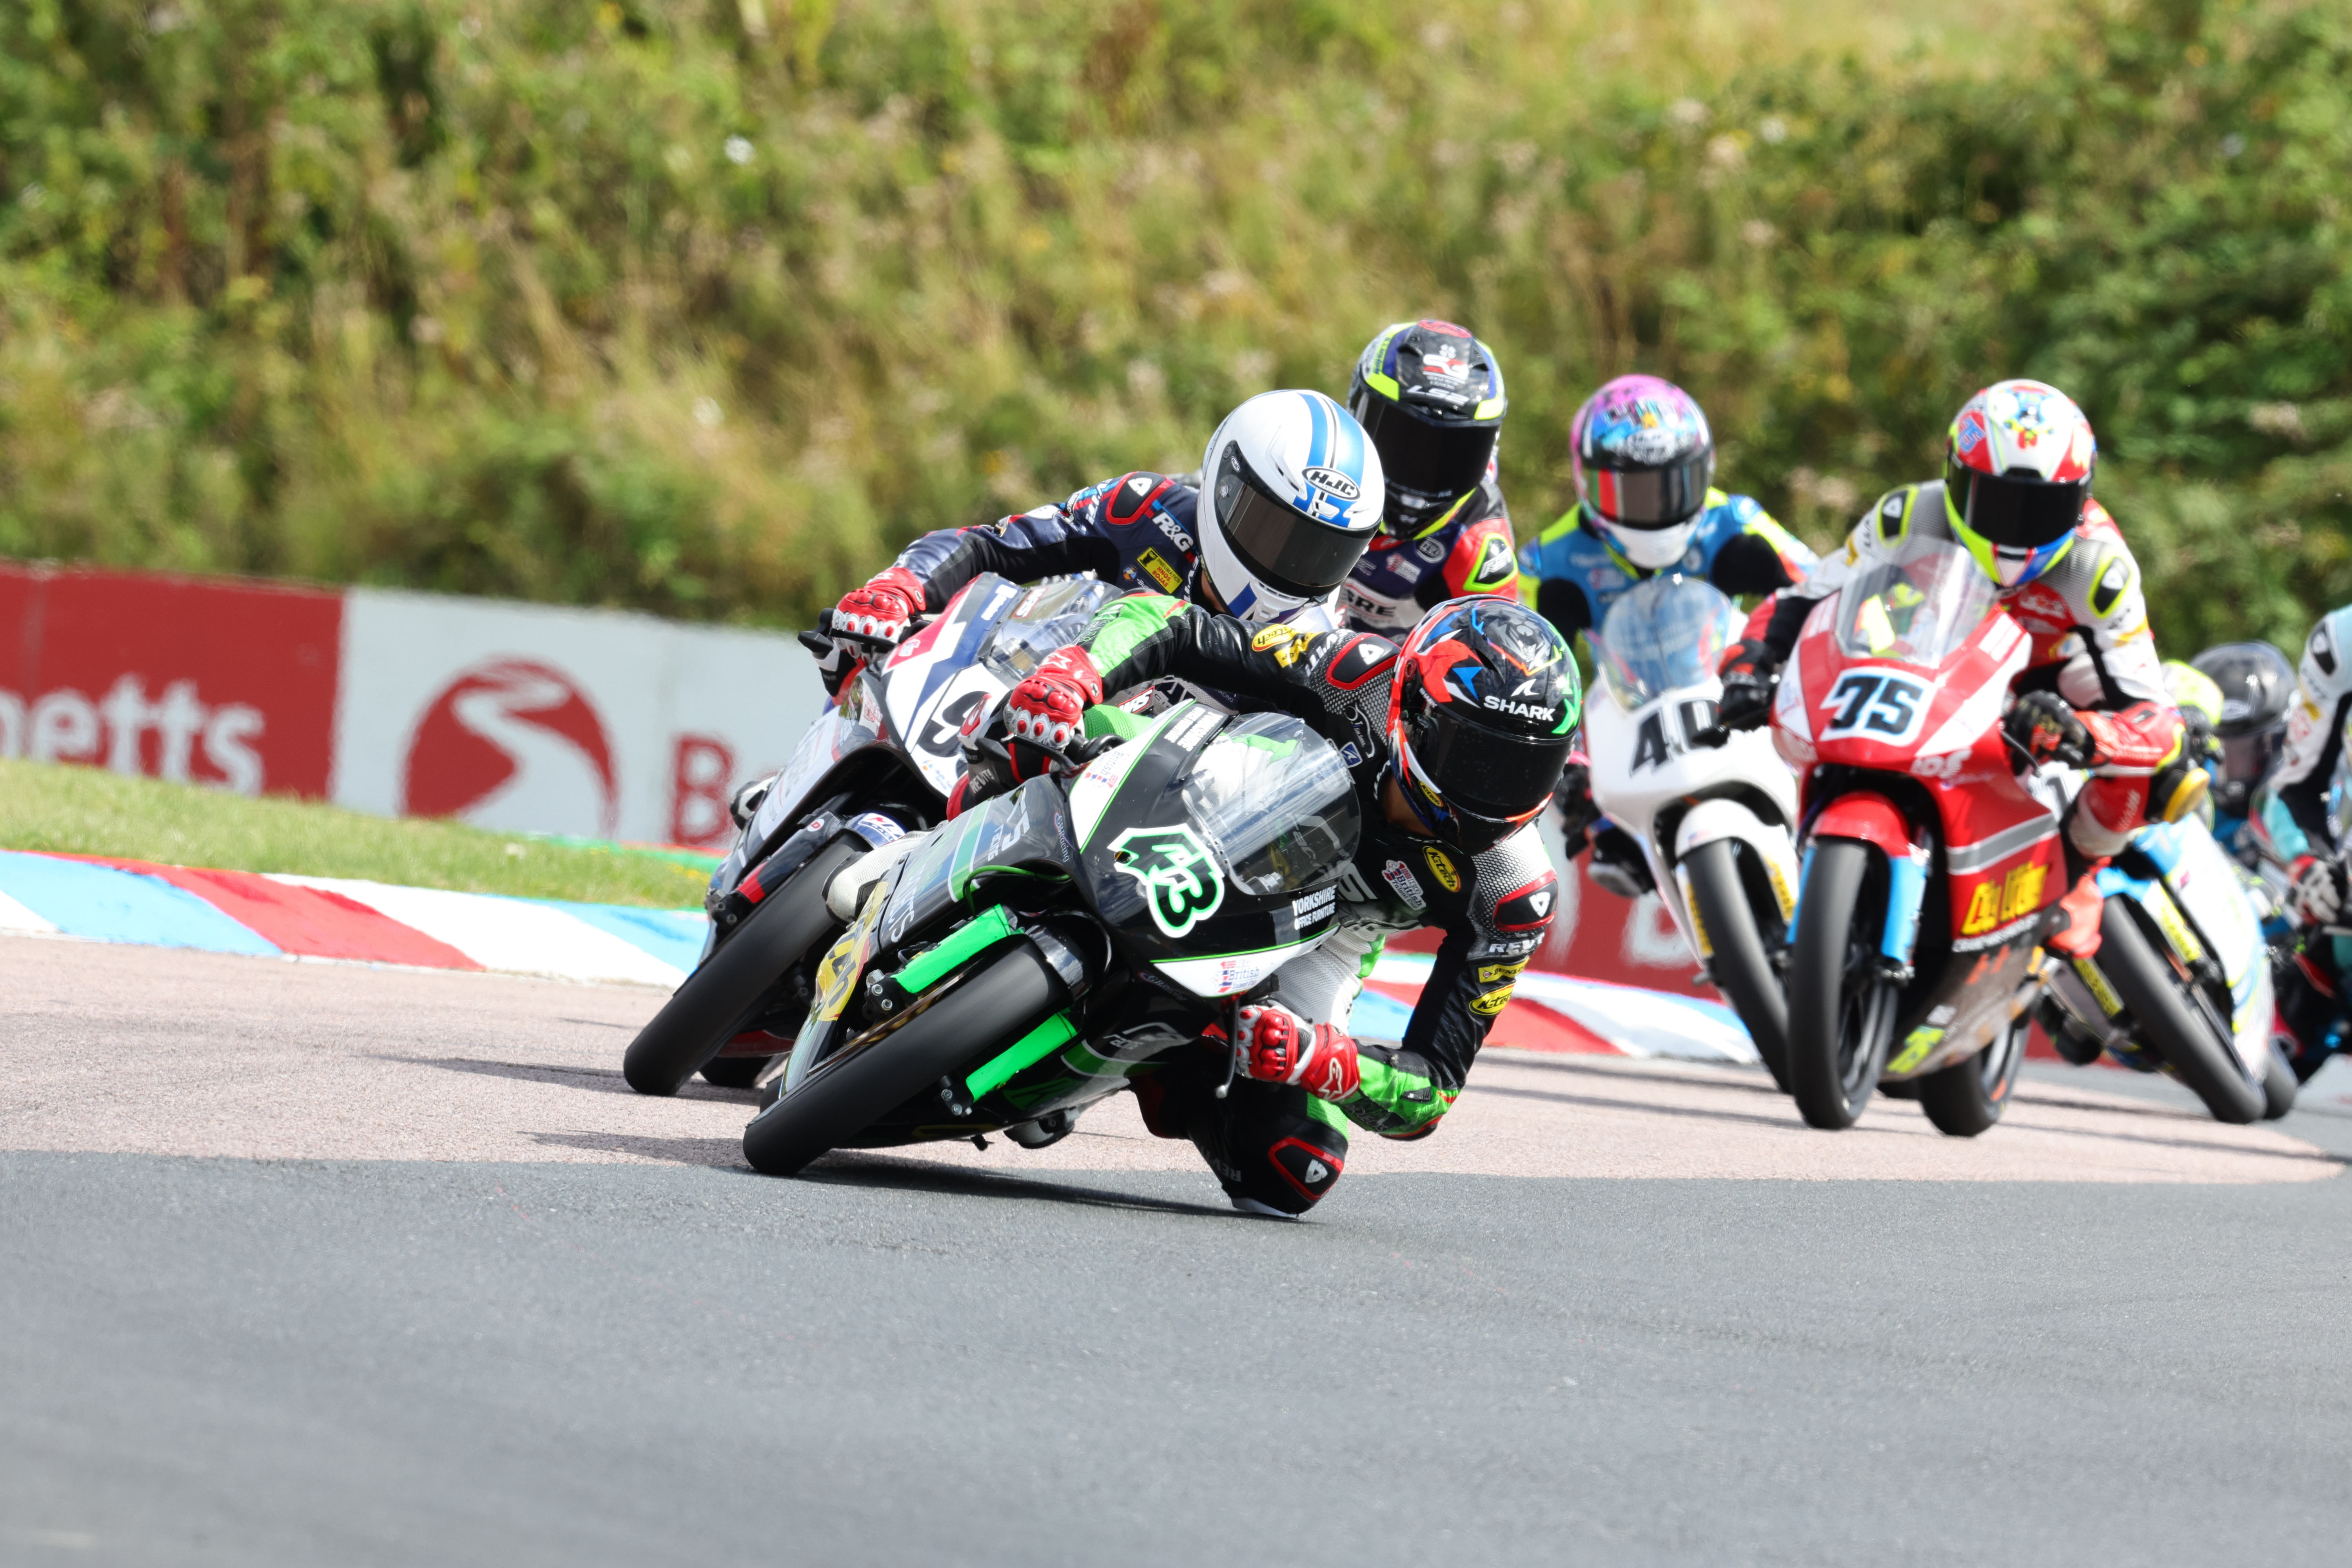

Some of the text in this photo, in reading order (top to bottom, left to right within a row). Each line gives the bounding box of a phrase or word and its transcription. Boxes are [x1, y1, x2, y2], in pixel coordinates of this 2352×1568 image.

[1309, 471, 1355, 498] HJC
[1152, 512, 1194, 552] R&G
[1152, 571, 1169, 588] ROJAS
[1419, 687, 1437, 708] SHARK
[1483, 695, 1556, 722] SHARK
[1824, 673, 1925, 736] 75
[1100, 751, 1124, 775] British
[1112, 827, 1221, 934] 43
[1427, 852, 1456, 887] K-tech
[1292, 884, 1338, 916] YORKSHIRE
[1392, 880, 1408, 899] Talent
[1396, 873, 1423, 907] British
[1294, 902, 1336, 930] OFFICE FURNITURE
[1229, 967, 1260, 980] British
[1494, 966, 1524, 976] DUNLO
